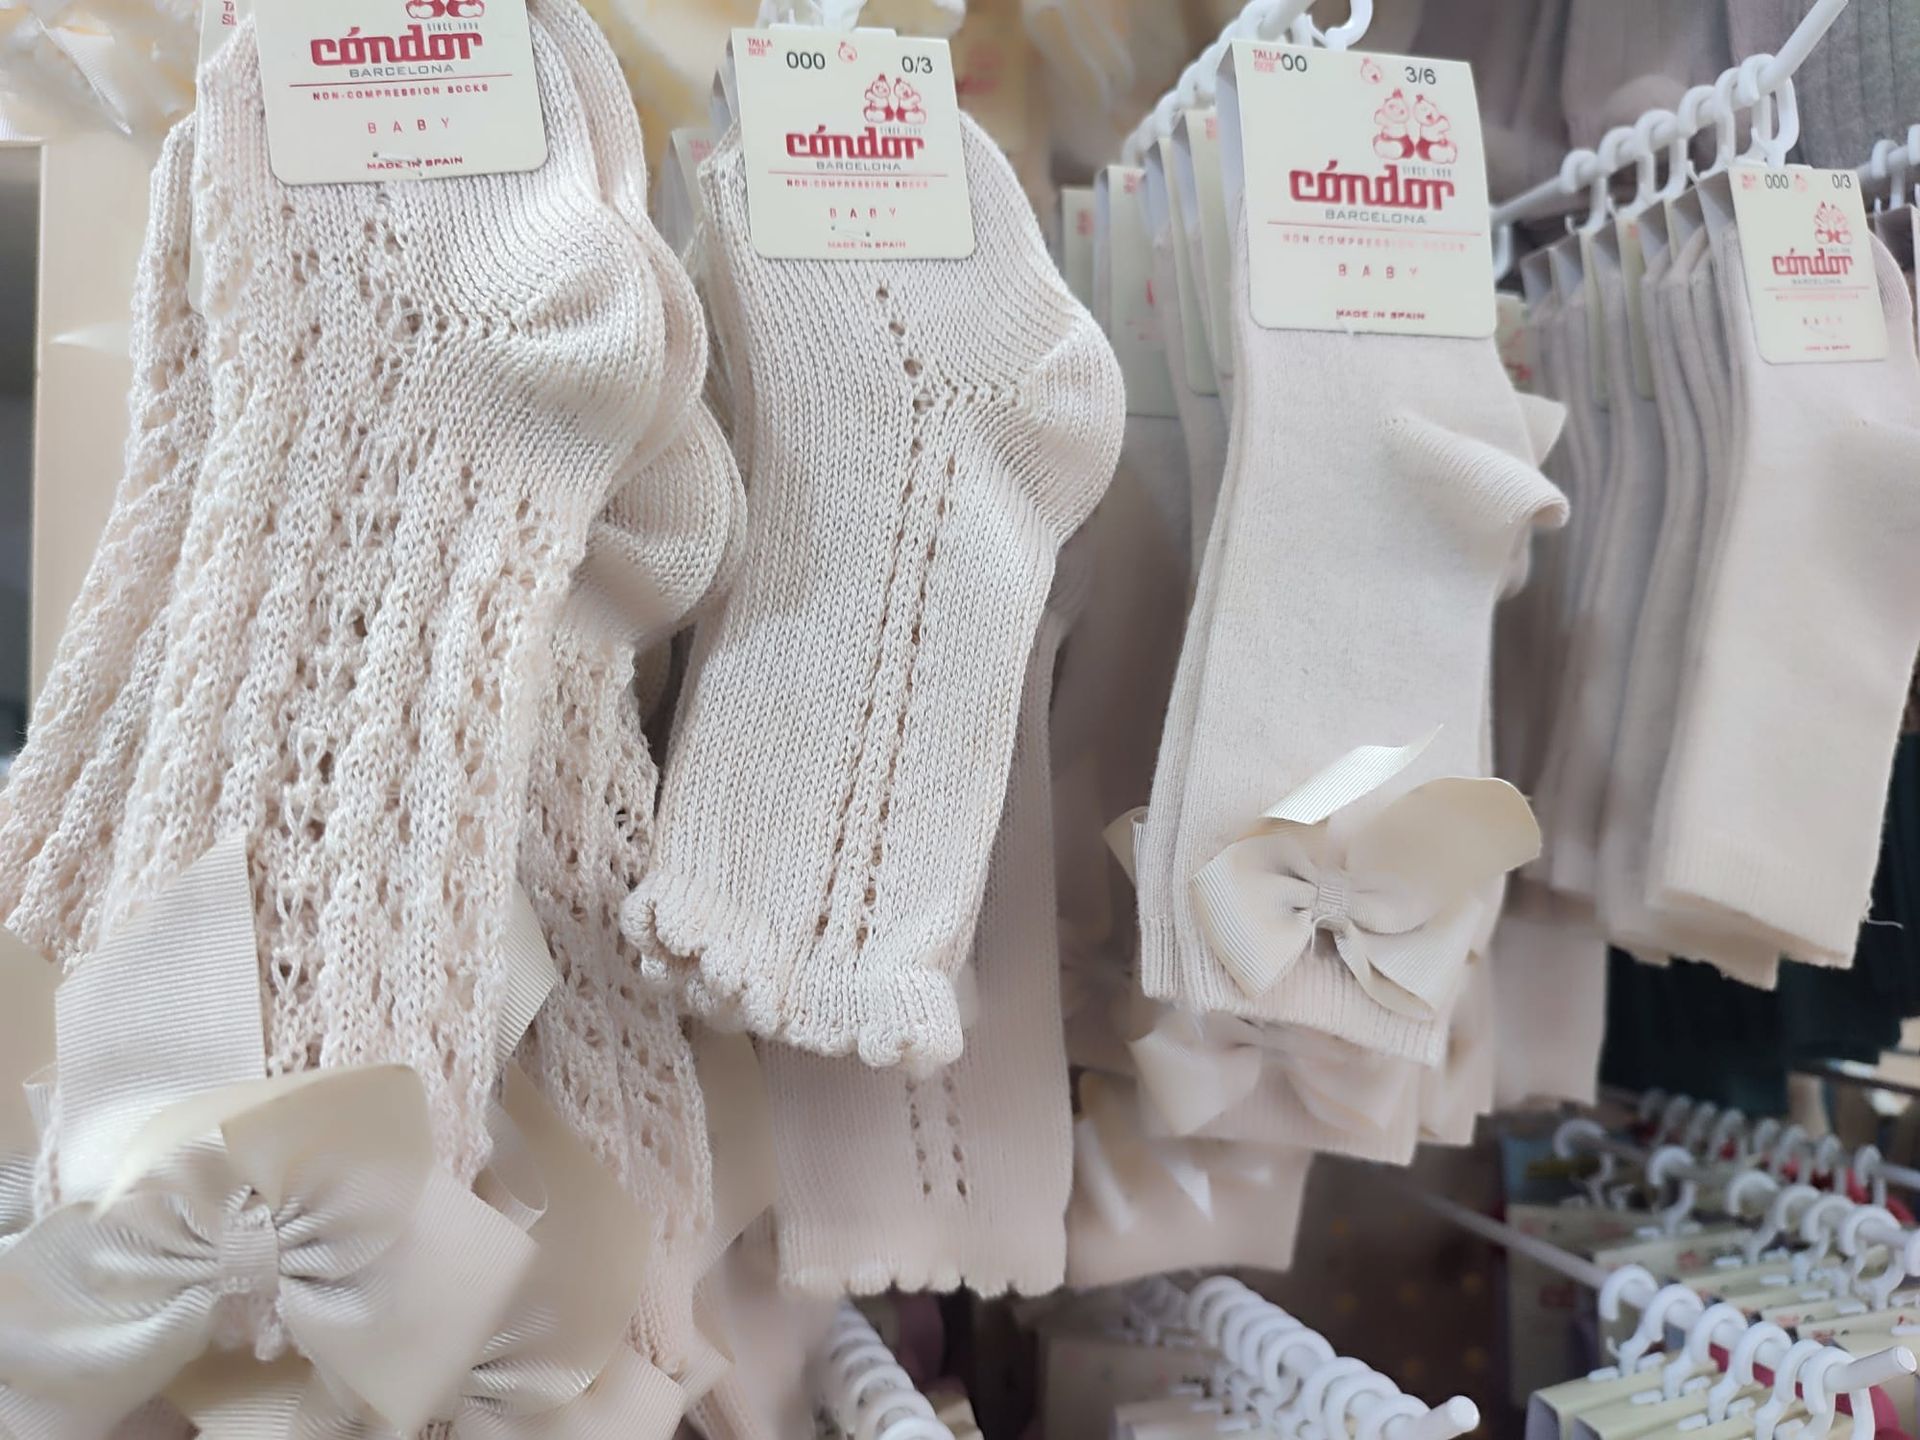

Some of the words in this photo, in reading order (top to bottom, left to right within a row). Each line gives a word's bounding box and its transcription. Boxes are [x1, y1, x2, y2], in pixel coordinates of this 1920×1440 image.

[310, 25, 483, 66] cóndor
[786, 51, 826, 70] 000
[902, 56, 933, 74] 0/3
[1281, 53, 1308, 72] 00
[349, 64, 455, 78] BARCELONA
[1404, 66, 1437, 85] 3/6
[313, 86, 440, 100] NON-COMPRESSION
[447, 84, 489, 94] SOCKS
[367, 117, 450, 134] BABY
[786, 124, 925, 159] cóndor
[367, 161, 403, 170] MADE
[426, 156, 463, 167] SPAIN
[816, 161, 902, 171] BARCELONA
[1289, 160, 1455, 211] cóndor
[1765, 174, 1789, 190] 000
[1832, 174, 1852, 190] 0/3
[829, 207, 897, 219] BABY
[1325, 209, 1426, 224] BARCELONA
[1772, 248, 1854, 275] cóndor
[1338, 263, 1418, 279] BABY
